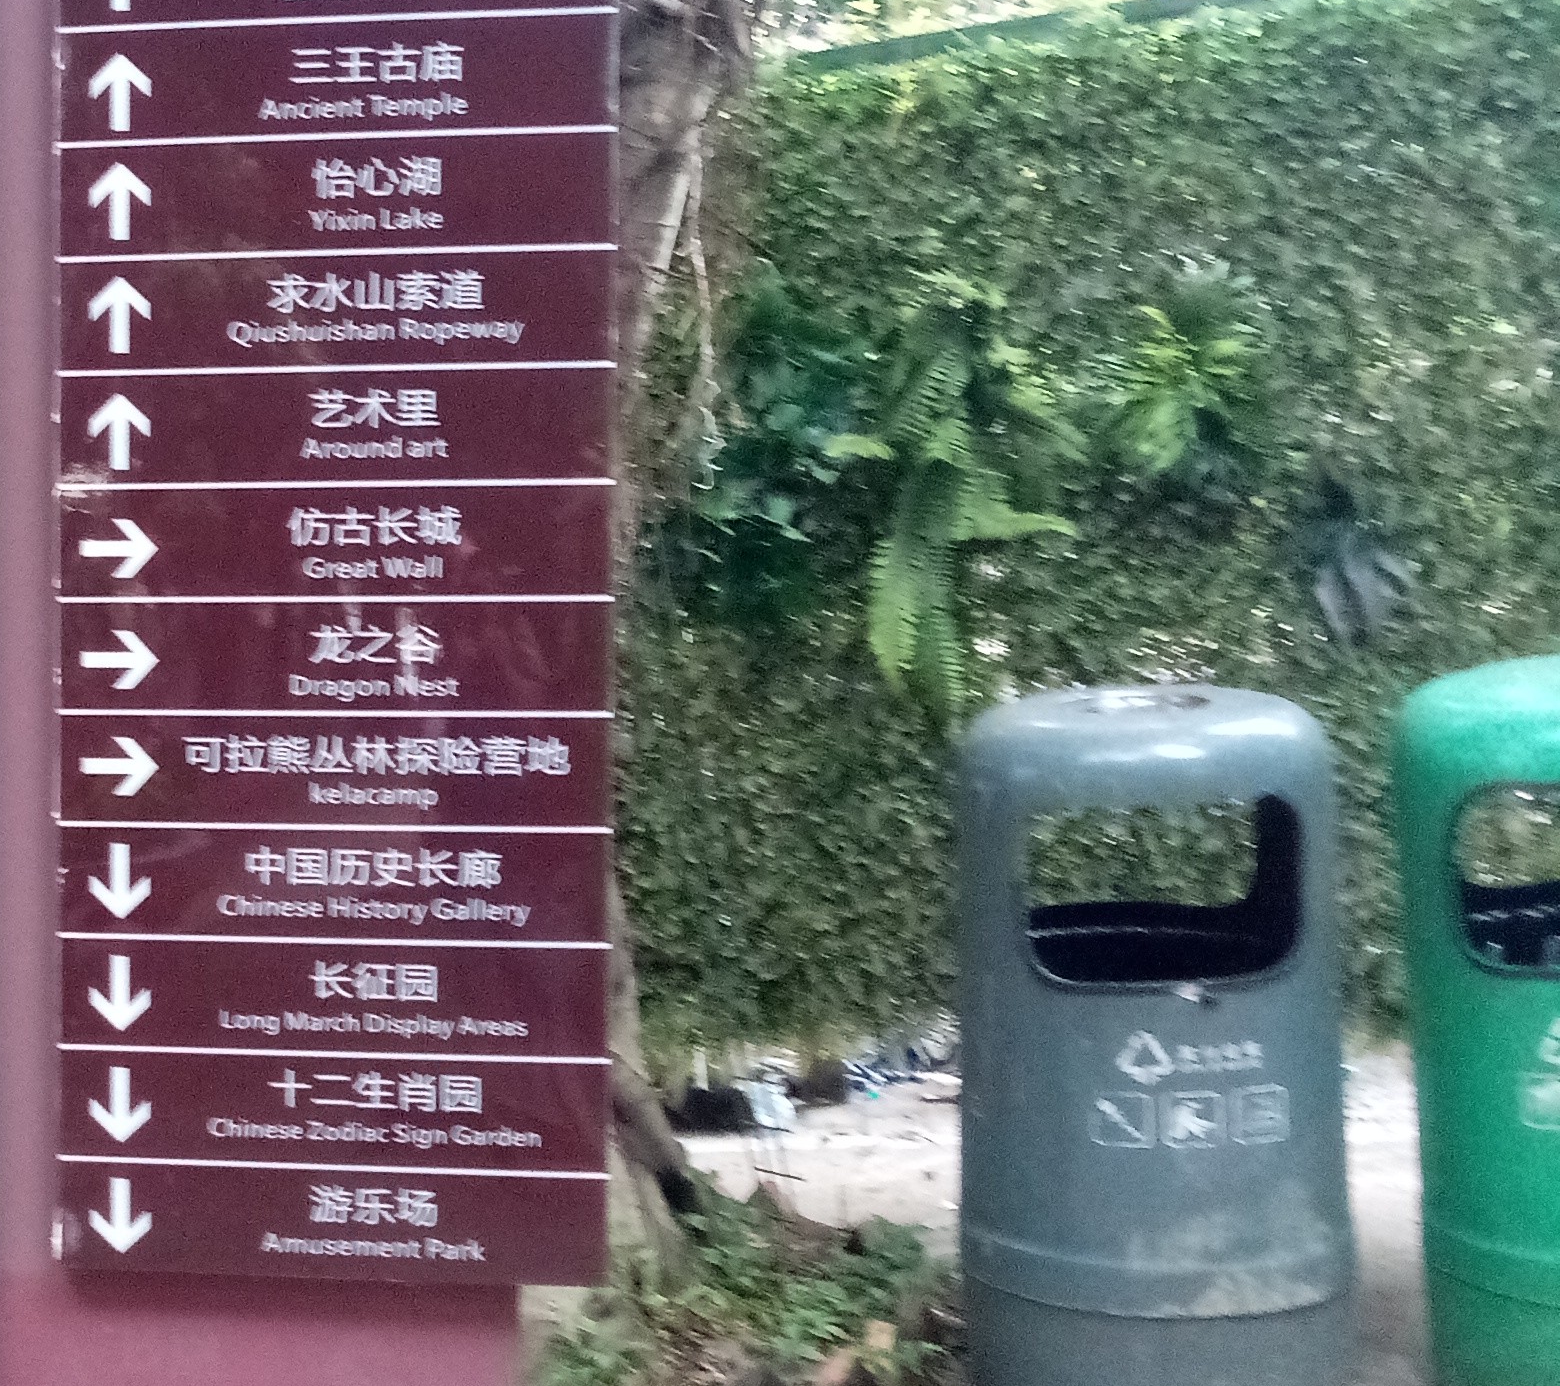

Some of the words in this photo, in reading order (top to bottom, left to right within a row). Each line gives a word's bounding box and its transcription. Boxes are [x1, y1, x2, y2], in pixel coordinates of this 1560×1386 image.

[290, 41, 465, 83] 三王古庙
[258, 96, 365, 120] Ancient
[368, 91, 469, 121] Temple
[311, 154, 442, 198] 怡心湖
[308, 208, 377, 232] Yixin
[379, 206, 444, 231] Lake
[266, 269, 484, 314] 求水山索道
[226, 317, 396, 348] Qiushuishan
[397, 316, 525, 345] Ropeway
[309, 388, 440, 428] 艺术里
[300, 435, 404, 460] Around
[405, 437, 448, 459] art
[287, 505, 463, 546] 仿古长城
[300, 556, 379, 580] Great
[381, 554, 444, 579] Wall
[309, 621, 442, 666] 龙之谷
[288, 673, 391, 702] Dragon
[182, 734, 571, 775] 可拉熊丛林探险营地
[244, 845, 502, 888] 中国历史长廊
[216, 893, 324, 918] Chinese
[326, 895, 429, 925] History
[427, 897, 531, 927] Gallery
[309, 960, 439, 1002] 长征园
[218, 1010, 282, 1036] Long
[283, 1011, 362, 1033] March
[361, 1012, 456, 1041] Display
[453, 1015, 529, 1037] Areas
[268, 1068, 483, 1113] 十二生肖园
[206, 1117, 304, 1141] Chinese
[305, 1119, 389, 1143] Zodiac
[390, 1122, 450, 1150] Sign
[448, 1124, 543, 1148] Garden
[309, 1185, 439, 1227] 游乐场
[260, 1231, 422, 1260] Amusement
[424, 1237, 485, 1261] Park
